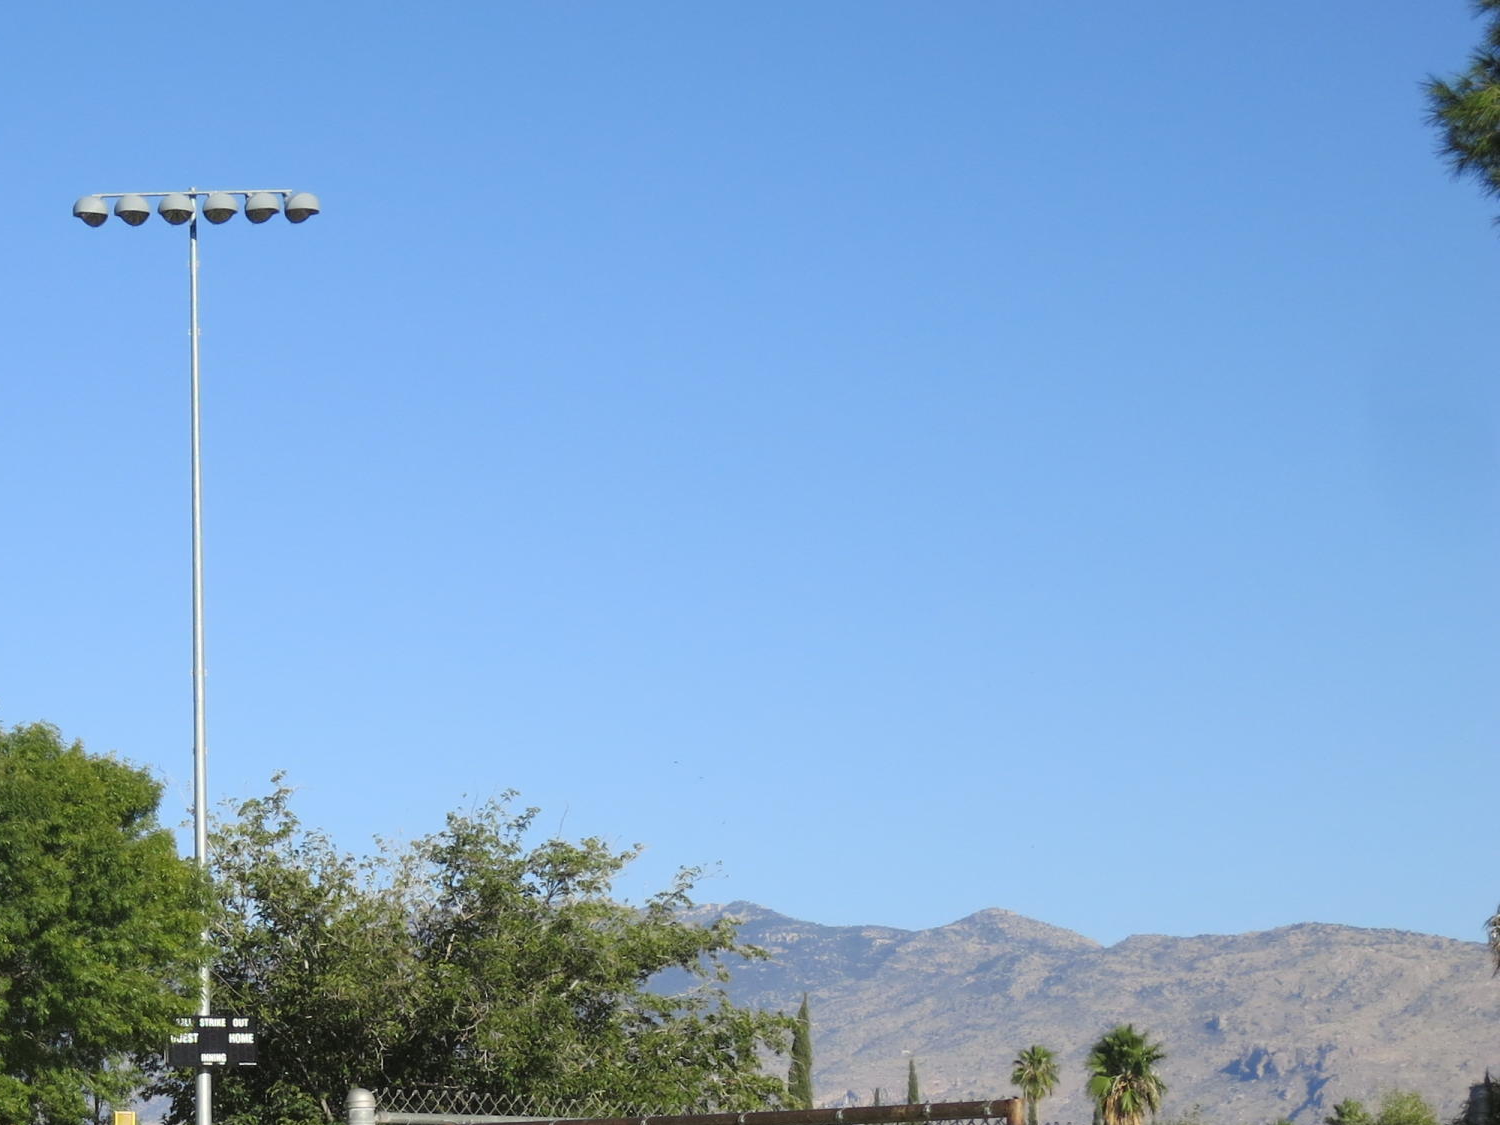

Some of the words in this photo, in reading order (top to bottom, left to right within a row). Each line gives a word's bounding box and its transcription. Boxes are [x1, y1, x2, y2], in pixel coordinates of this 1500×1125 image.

[199, 1018, 227, 1027] STRIKE
[232, 1018, 249, 1027] OUT
[170, 1032, 199, 1044] GUEST
[228, 1033, 254, 1044] HOME
[200, 1053, 227, 1062] INNING
